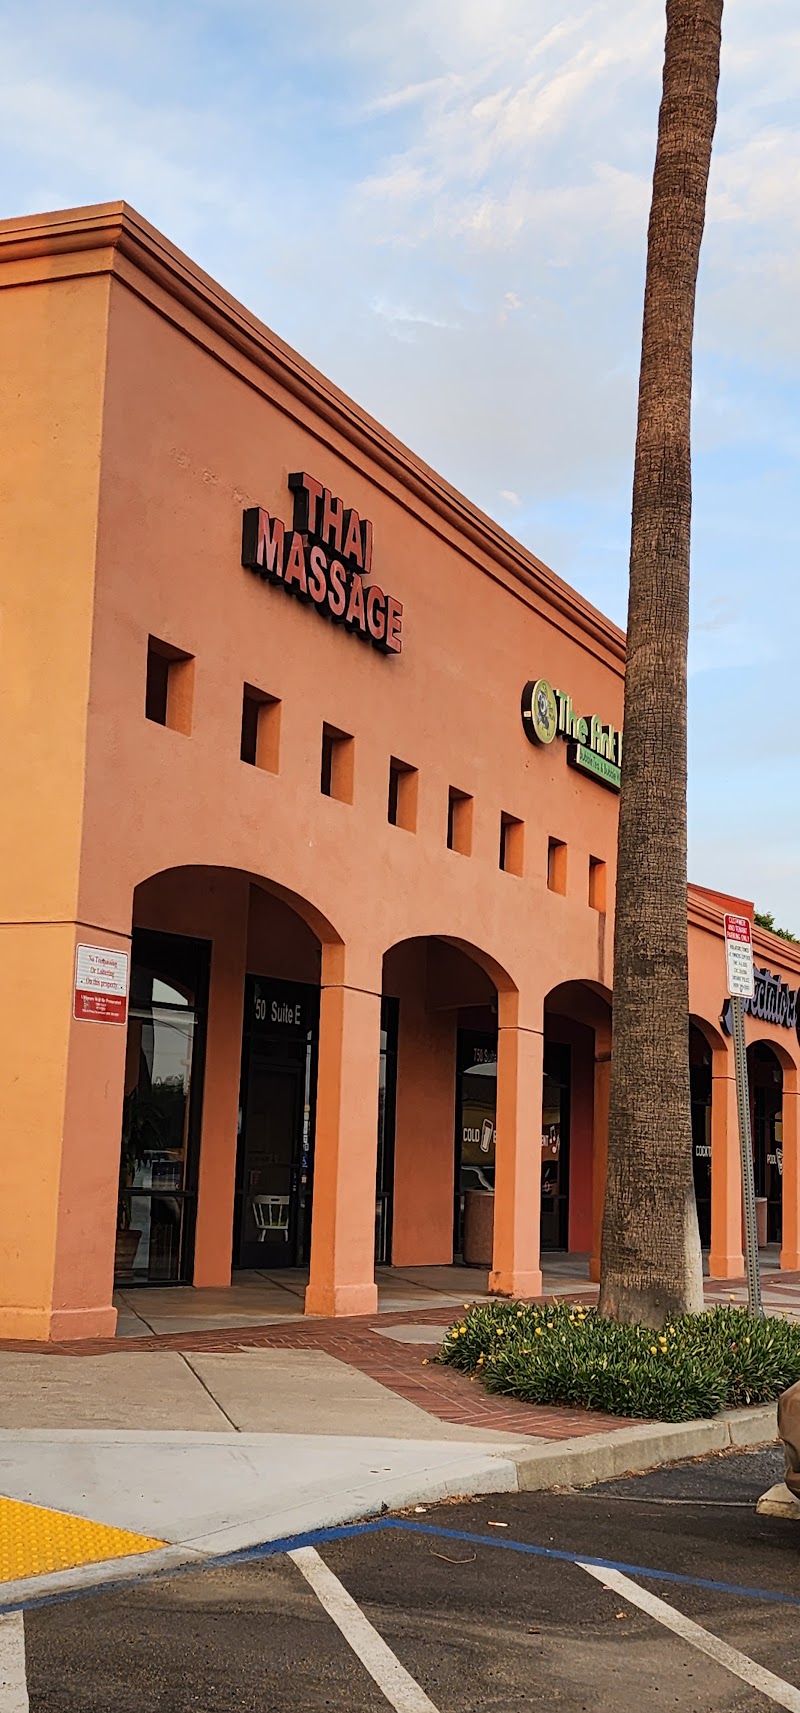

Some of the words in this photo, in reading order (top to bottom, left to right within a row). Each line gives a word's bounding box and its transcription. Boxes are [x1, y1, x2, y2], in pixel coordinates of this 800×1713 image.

[296, 471, 372, 574] THAI
[249, 506, 403, 654] MASSAGE
[556, 689, 588, 744] The
[254, 998, 266, 1020] 50
[271, 1001, 293, 1023] Suite
[295, 1004, 301, 1025] E
[463, 1128, 480, 1142] COLD
